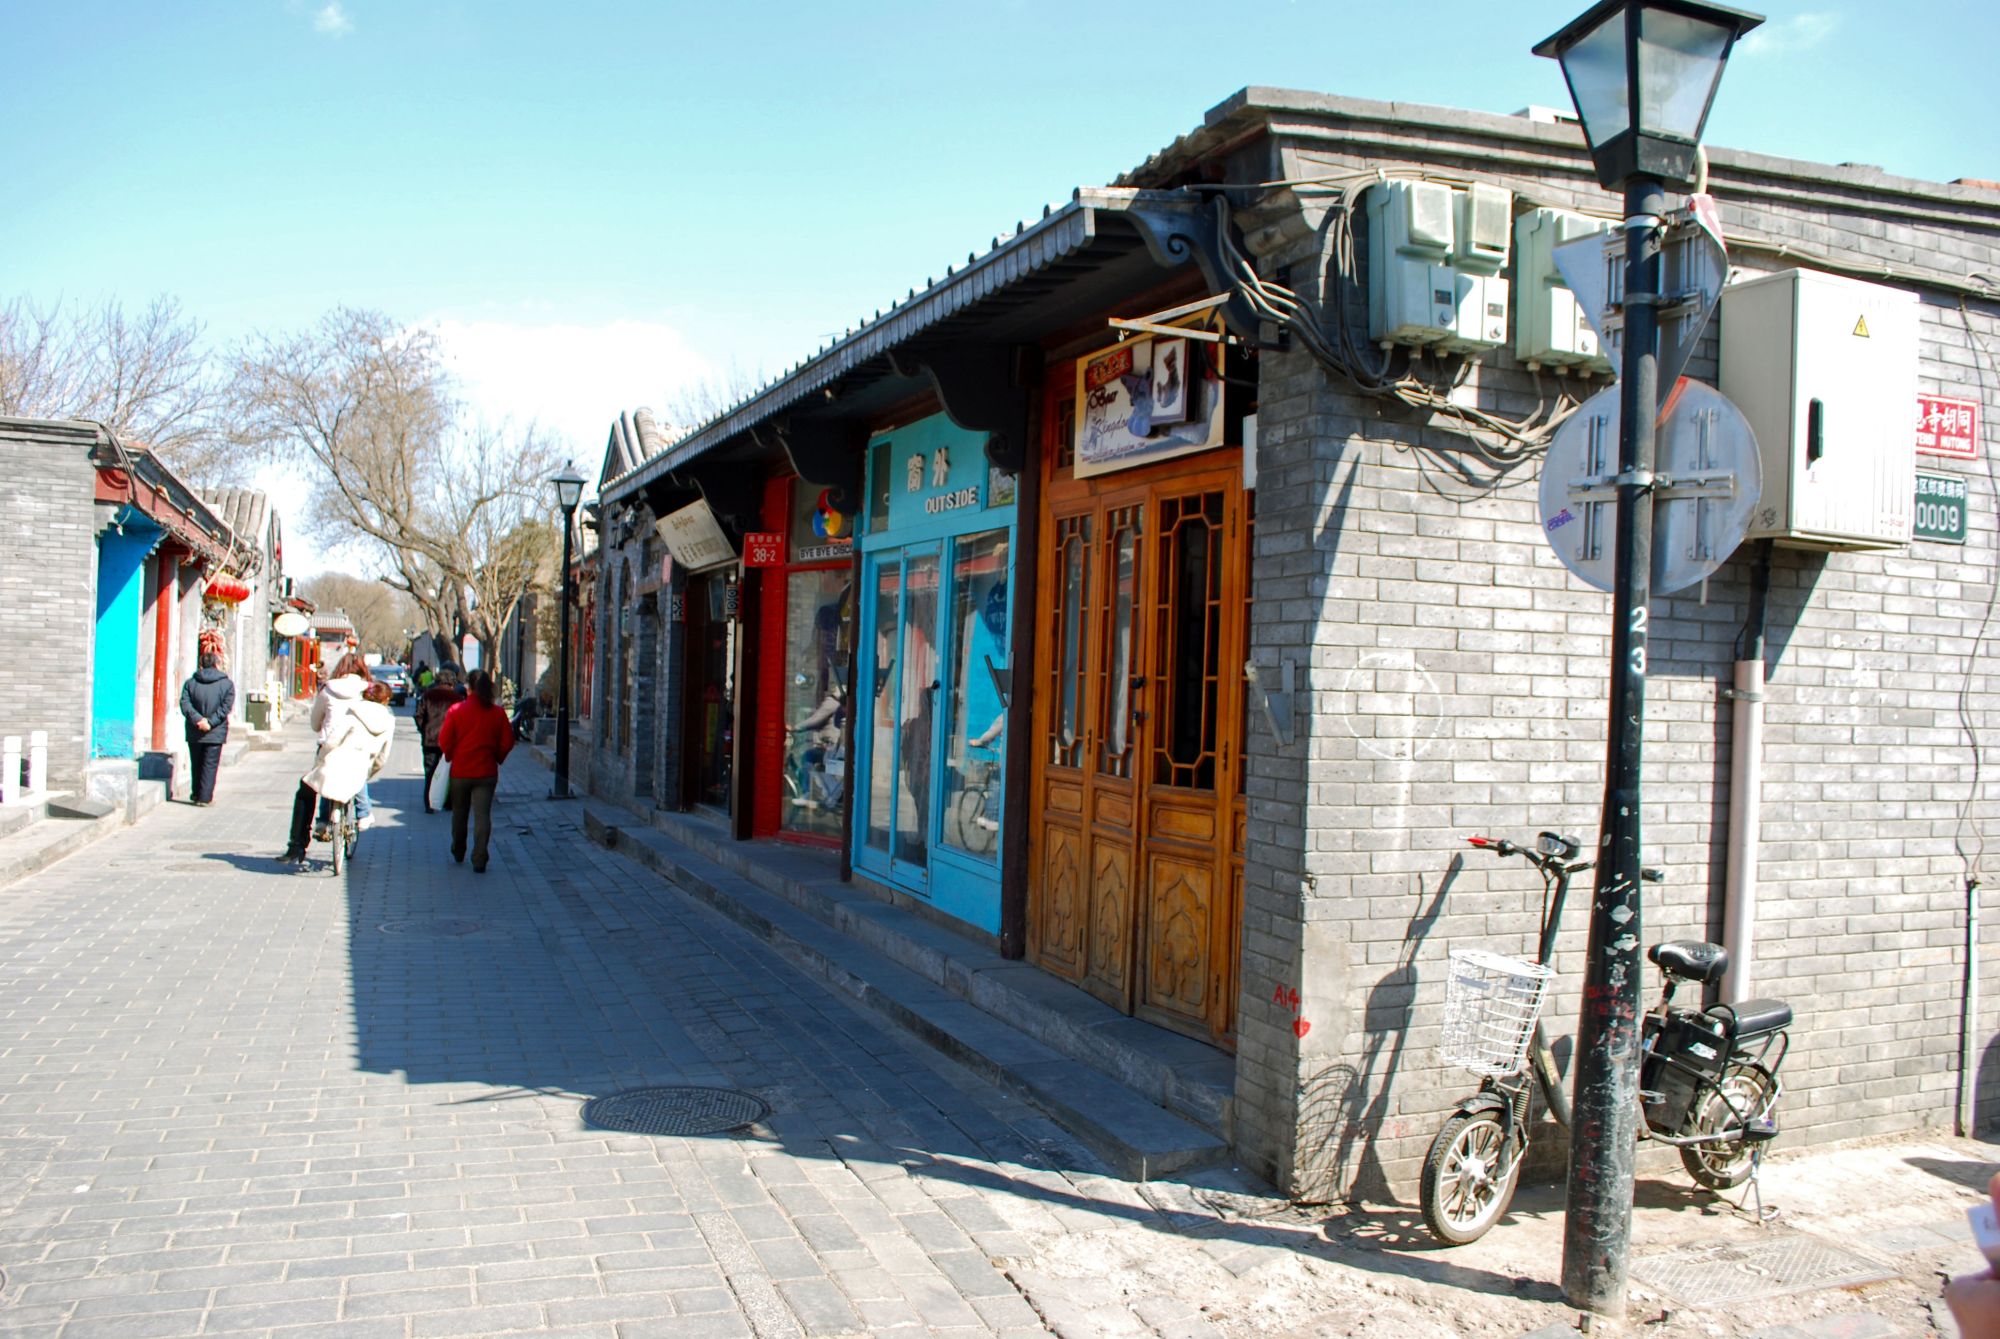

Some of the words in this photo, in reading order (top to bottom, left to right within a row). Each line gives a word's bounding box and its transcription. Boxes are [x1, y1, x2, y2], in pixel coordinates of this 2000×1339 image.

[1093, 413, 1129, 438] Kingdo
[924, 486, 977, 514] OUTSIDE
[752, 547, 776, 563] 38-2
[800, 548, 815, 559] BYE
[816, 546, 831, 557] BYE
[832, 543, 854, 555] DISC
